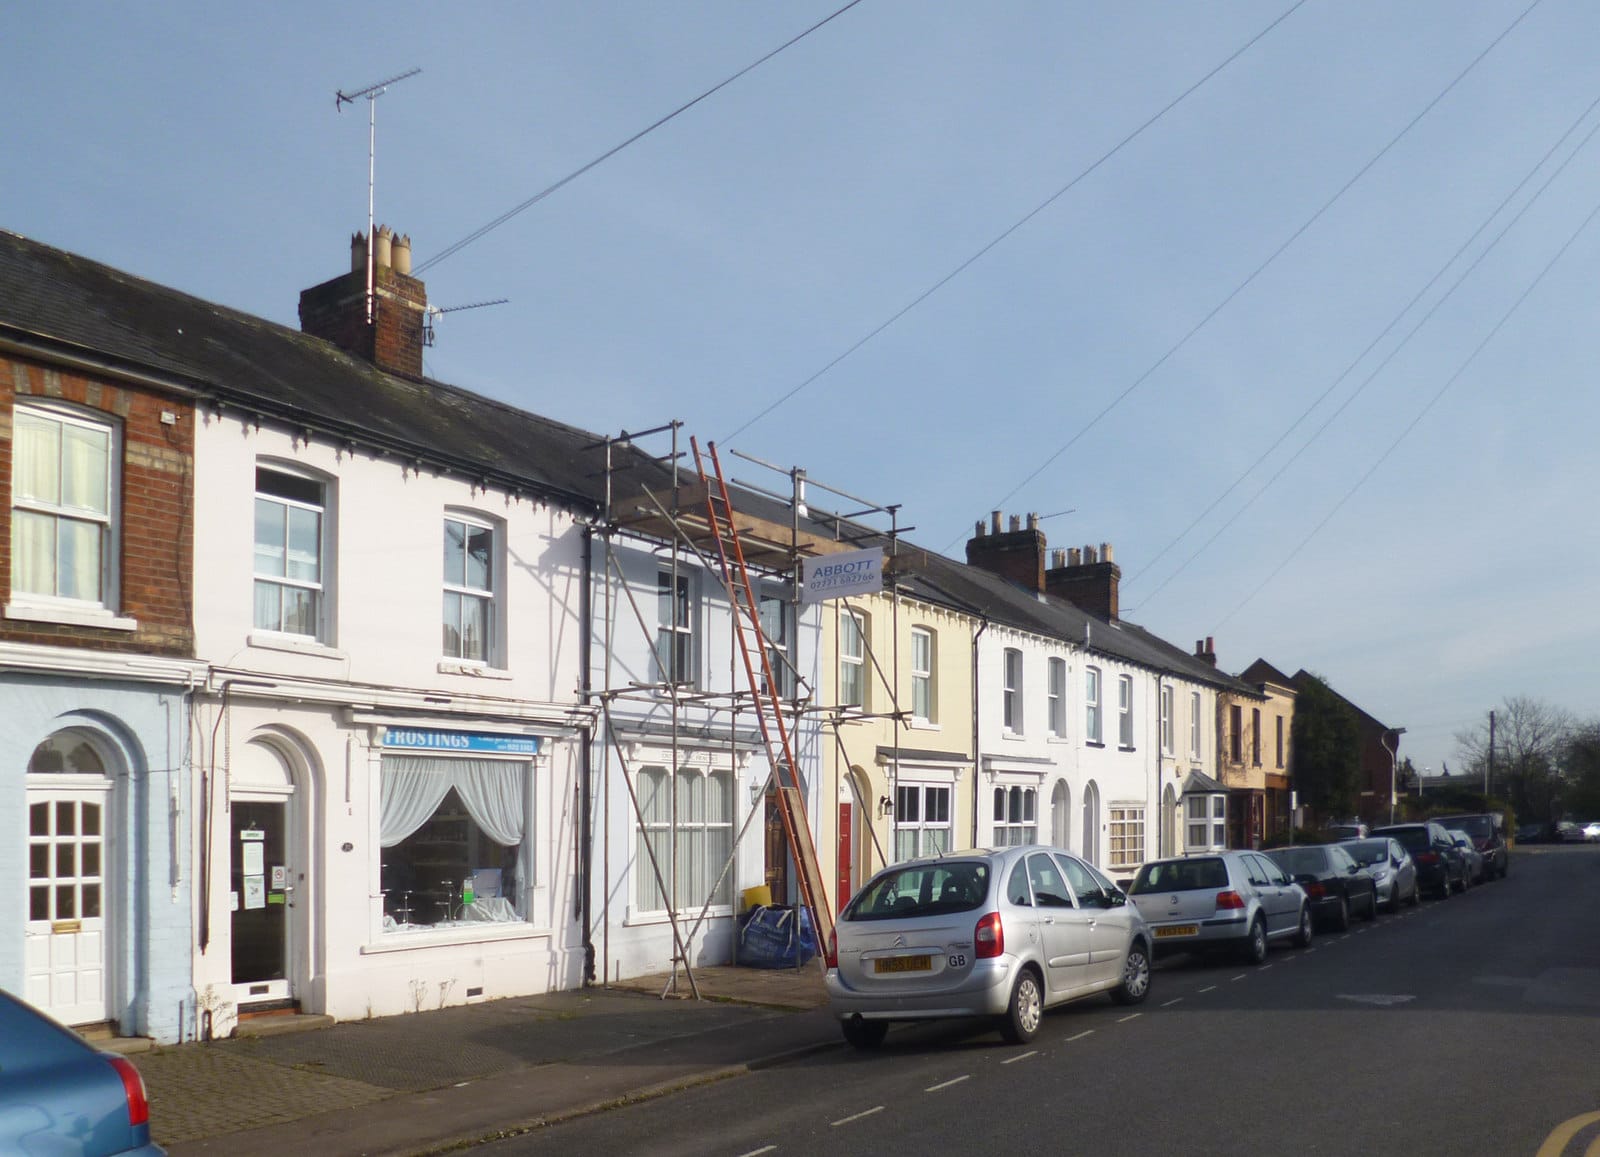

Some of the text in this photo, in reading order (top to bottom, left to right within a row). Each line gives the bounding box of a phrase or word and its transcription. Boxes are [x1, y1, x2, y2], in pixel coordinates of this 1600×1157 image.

[813, 560, 874, 578] ABBOTT
[386, 731, 470, 748] FROSTINGS
[948, 954, 966, 967] GB
